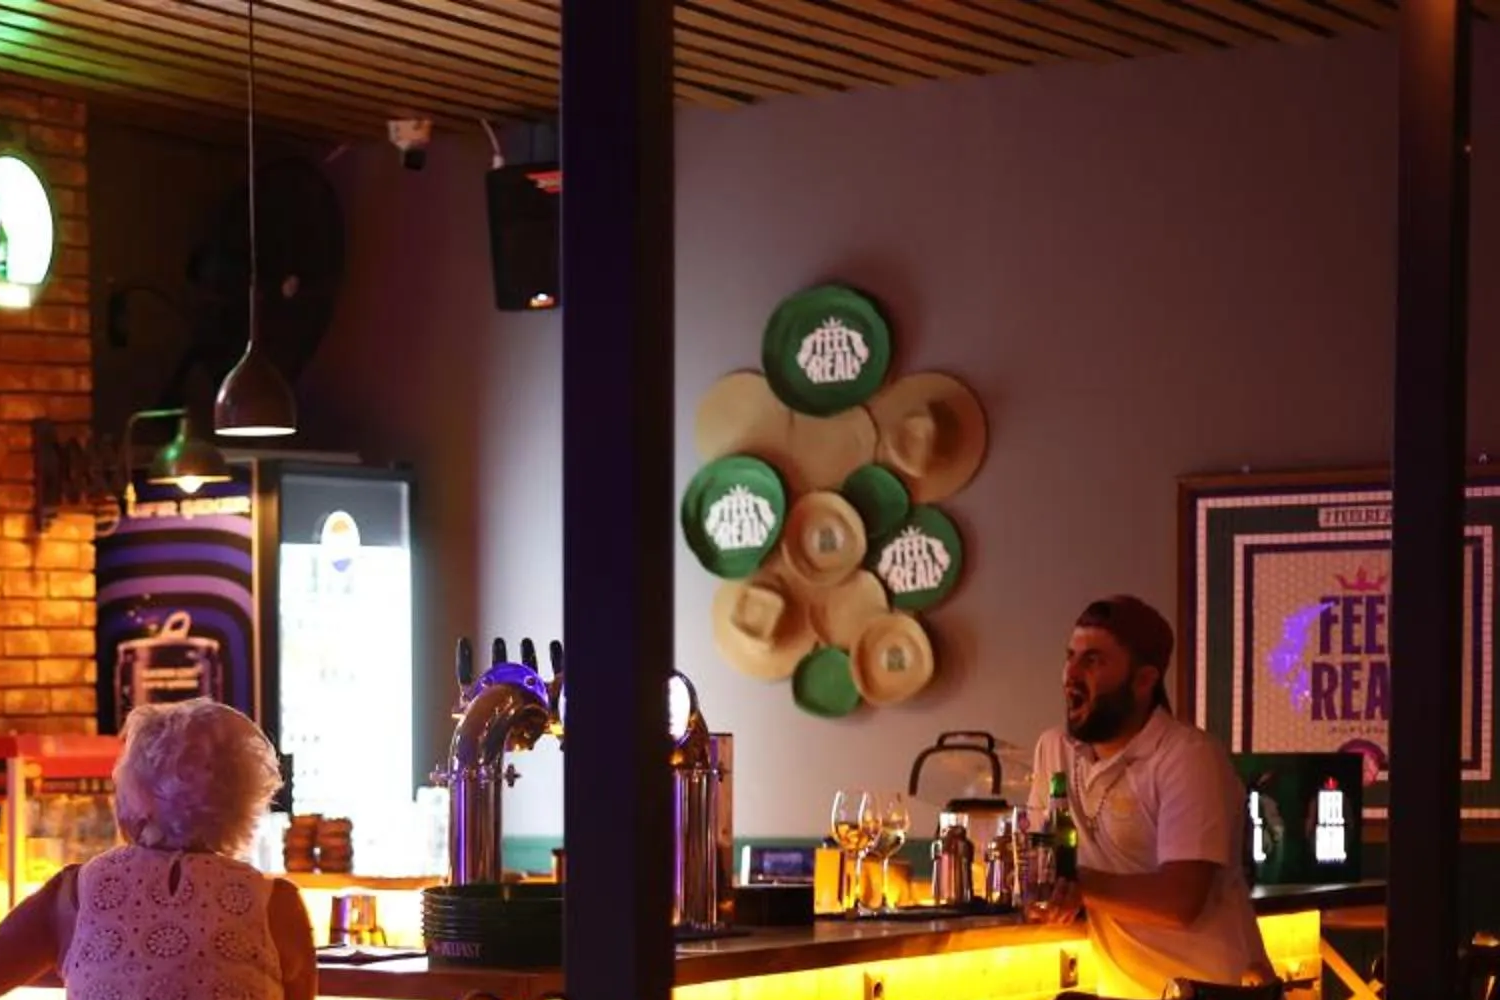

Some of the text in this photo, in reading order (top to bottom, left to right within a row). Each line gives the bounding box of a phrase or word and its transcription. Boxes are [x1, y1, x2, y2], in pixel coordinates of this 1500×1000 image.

[805, 350, 861, 384] REAL
[887, 559, 943, 594] REAL
[1319, 595, 1386, 655] FEE
[1311, 661, 1389, 721] REA
